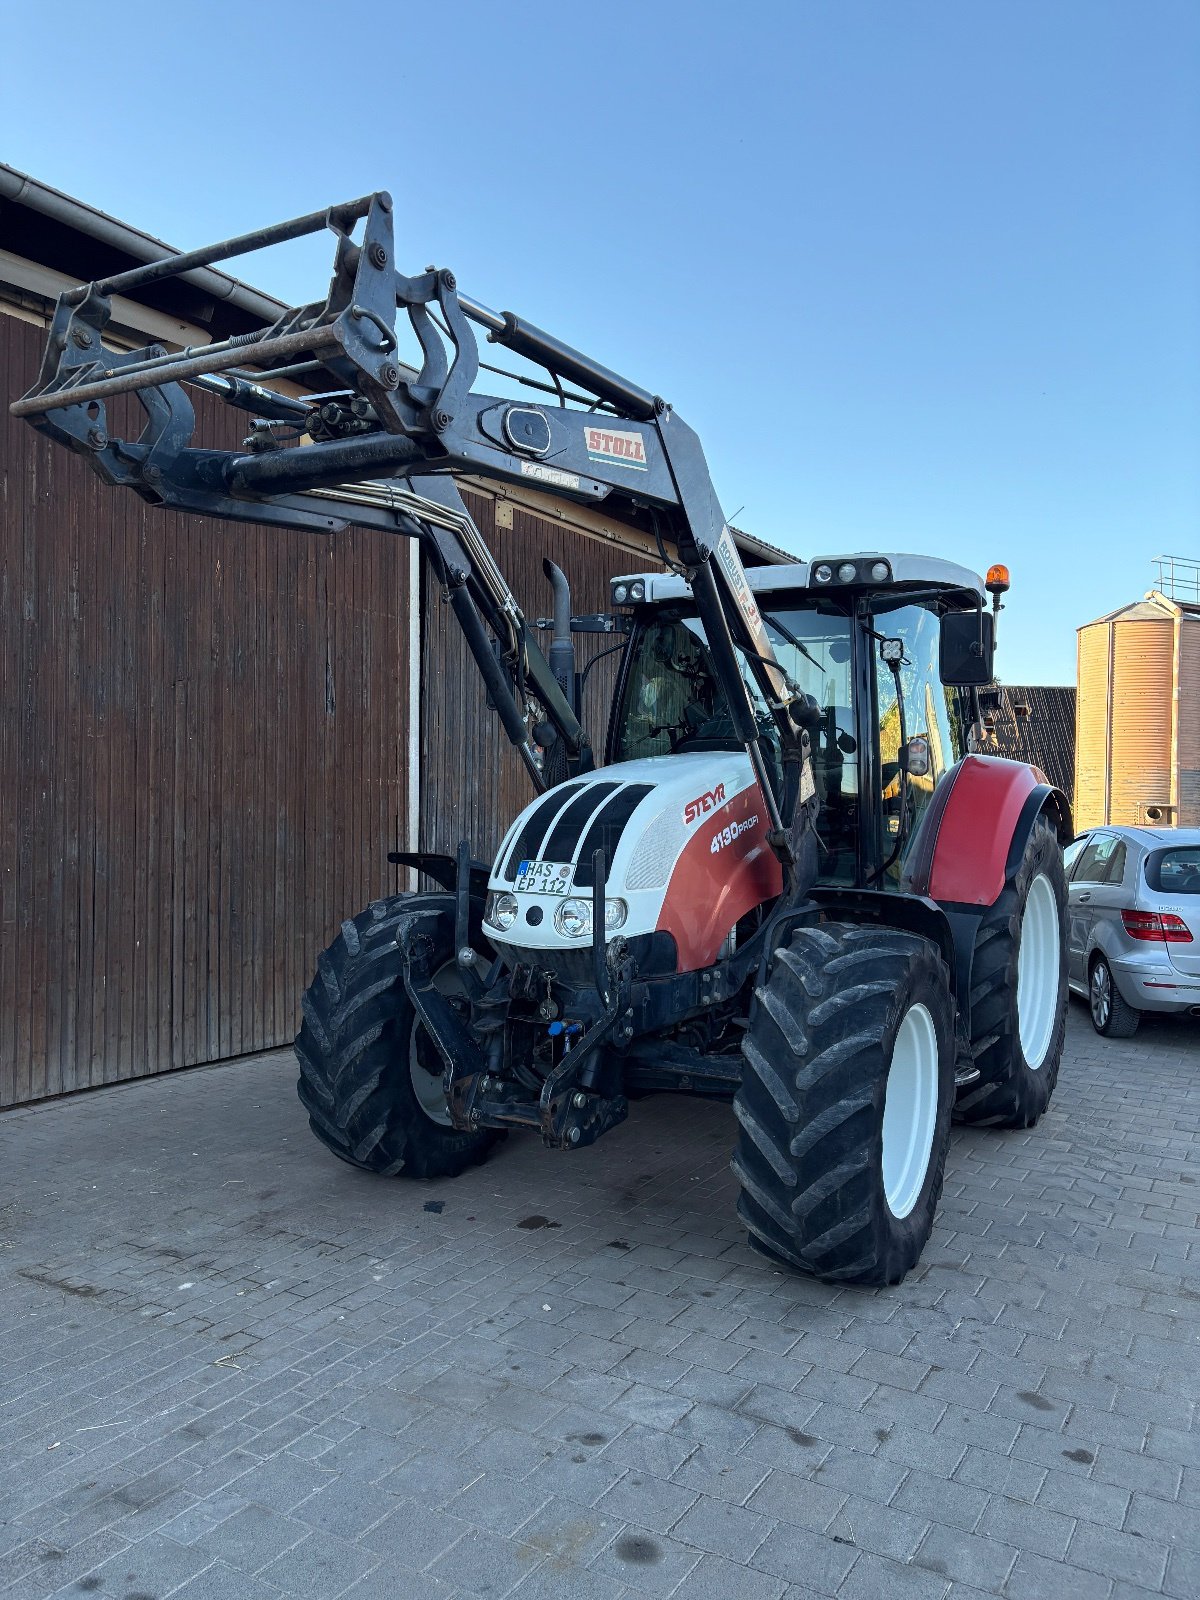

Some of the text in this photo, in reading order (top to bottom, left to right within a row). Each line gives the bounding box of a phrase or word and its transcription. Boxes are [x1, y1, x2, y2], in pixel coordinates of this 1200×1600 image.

[589, 431, 644, 460] STOLL
[719, 539, 745, 591] ROBUST
[748, 603, 761, 625] 31
[684, 783, 726, 825] STEYR
[526, 862, 553, 877] HAS
[517, 878, 566, 893] EP 112
